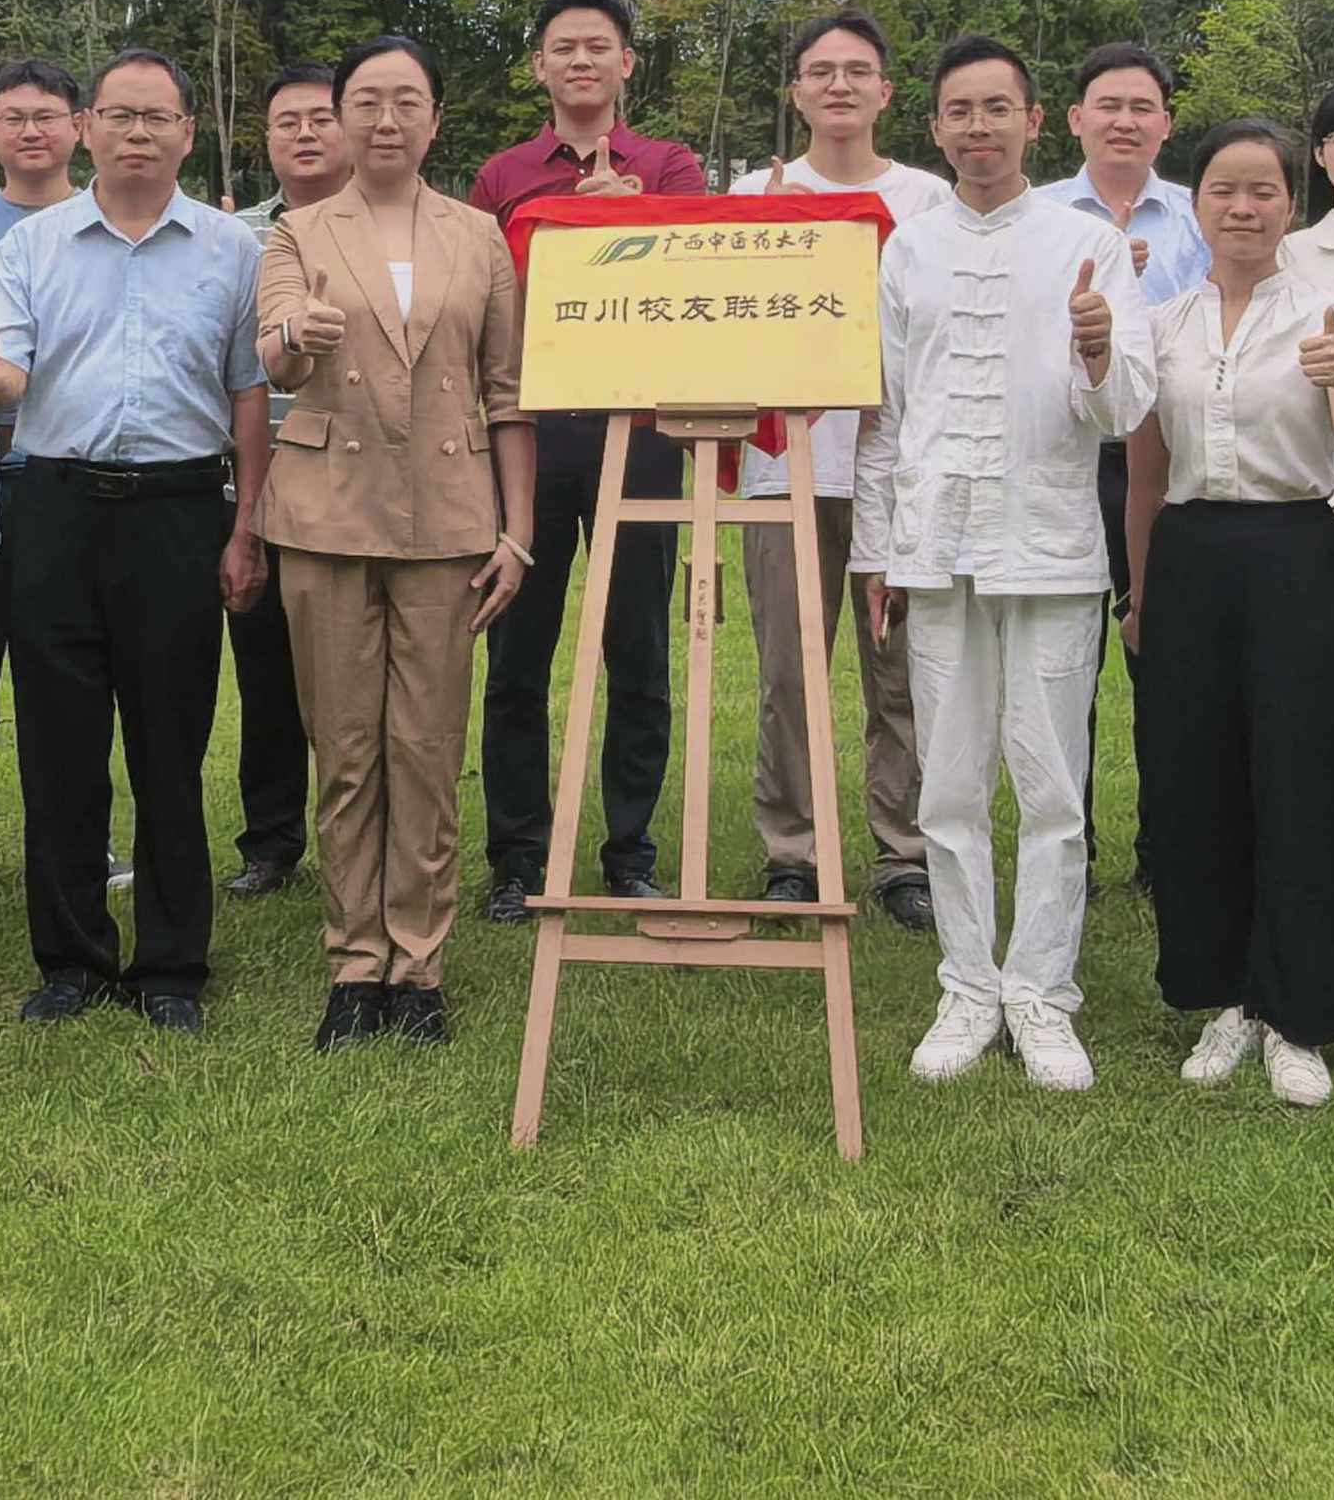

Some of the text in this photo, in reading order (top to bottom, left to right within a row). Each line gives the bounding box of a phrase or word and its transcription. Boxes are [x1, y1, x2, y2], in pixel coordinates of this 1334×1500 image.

[663, 229, 821, 254] 广西中医药大学
[555, 293, 847, 323] 四川校友联络处
